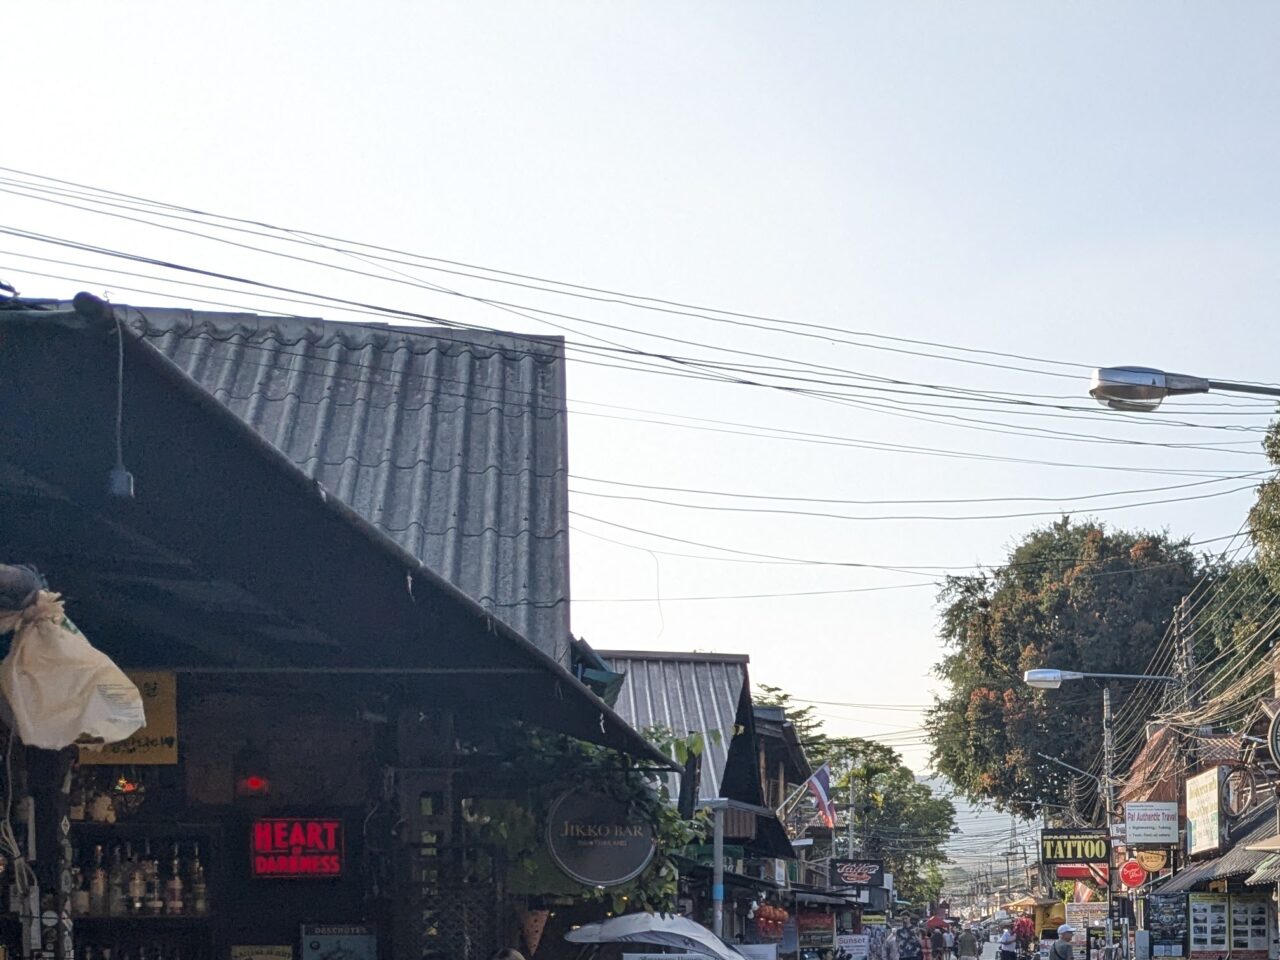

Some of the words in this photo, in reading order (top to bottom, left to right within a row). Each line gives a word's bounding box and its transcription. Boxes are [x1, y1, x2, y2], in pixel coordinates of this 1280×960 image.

[254, 822, 339, 851] HEART
[560, 820, 610, 837] JIKKO
[614, 823, 644, 837] BAR
[1043, 839, 1107, 859] TATTOO
